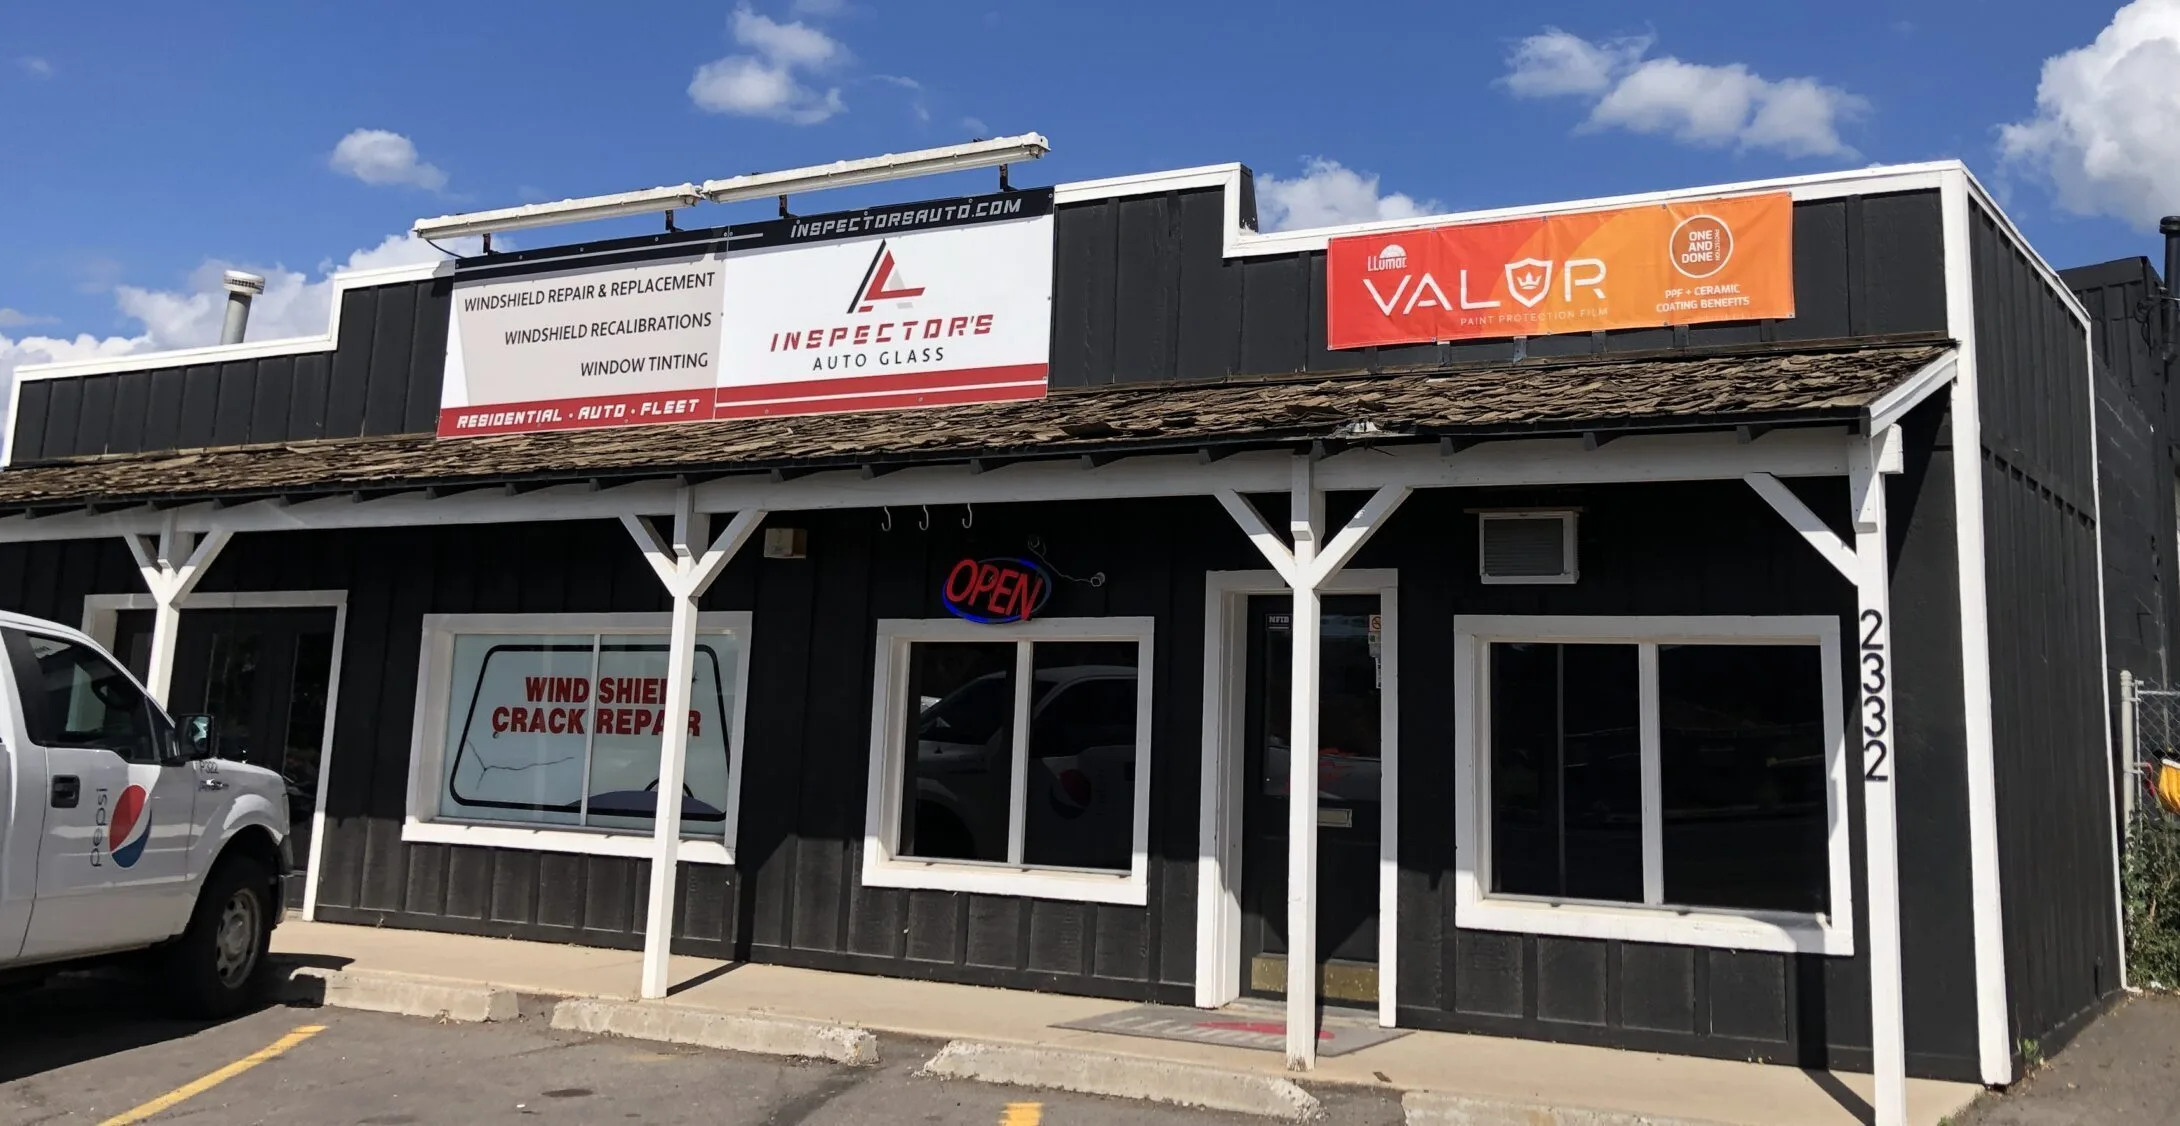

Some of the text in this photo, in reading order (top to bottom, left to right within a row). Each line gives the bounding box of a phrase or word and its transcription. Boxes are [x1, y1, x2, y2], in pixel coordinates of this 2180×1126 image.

[790, 198, 1022, 239] INSPECTORSAUTO.COM
[1688, 229, 1713, 241] ONE
[1688, 240, 1713, 252] AND
[1681, 251, 1713, 264] DONE
[464, 271, 715, 312] WINDSHIELD REPAIR & REPLACEMENT
[1656, 296, 1750, 313] COATING BENEFITS
[1664, 288, 1683, 299] PPF
[1694, 284, 1741, 296] CERAMIC
[504, 311, 712, 345] WINDSHIELD RECALIBRATIONS
[1460, 307, 1609, 326] PAINT PROTECTION FILM
[770, 313, 994, 352] INSPECTOR'S
[580, 352, 708, 377] WINDOW TINTING
[812, 347, 945, 371] AUTO GLASS
[456, 399, 700, 429] RESIDENTIAL AUTO FLEET
[945, 559, 1043, 622] OPEN
[525, 676, 668, 705] WIND SHIE
[1860, 608, 1889, 782] 2332
[492, 706, 702, 737] CRACK REPAR
[90, 788, 108, 867] pepsi
